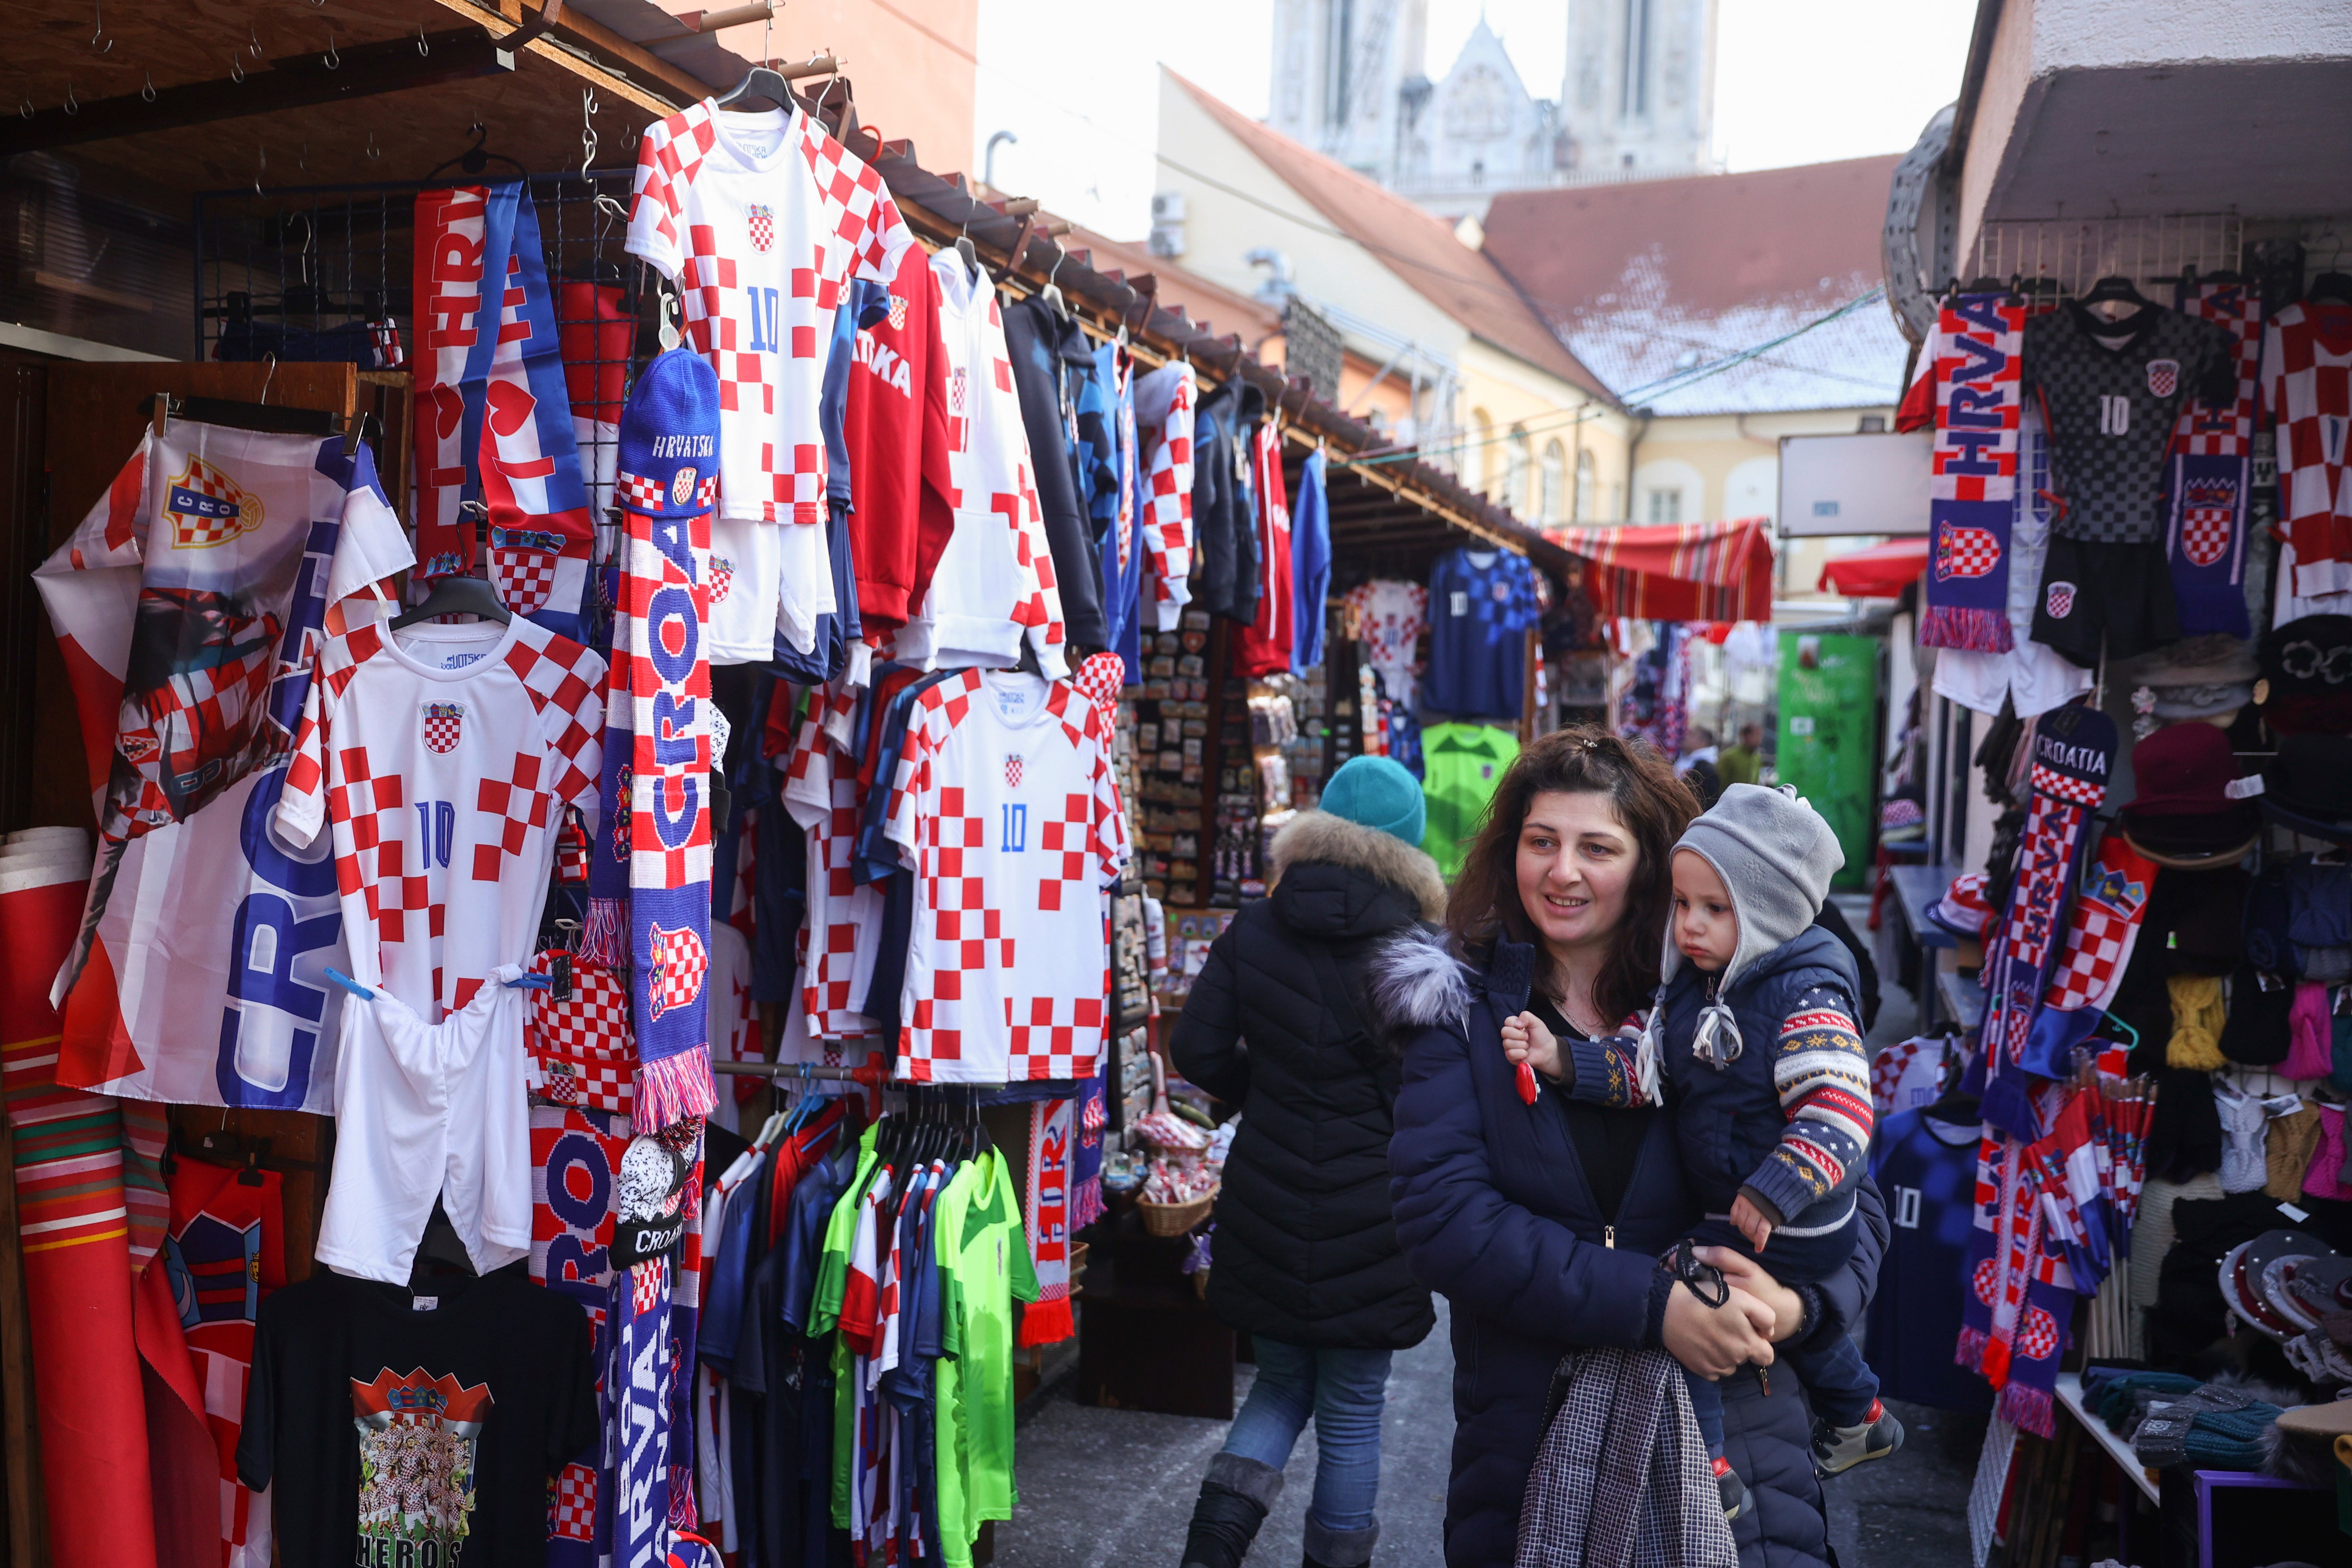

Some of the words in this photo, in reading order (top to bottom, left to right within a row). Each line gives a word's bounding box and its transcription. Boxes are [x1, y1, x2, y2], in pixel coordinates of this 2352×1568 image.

[748, 286, 778, 354] 10
[2100, 395, 2130, 435] 10
[652, 435, 714, 458] HRVATSKA
[177, 496, 230, 515] CRO
[2036, 733, 2106, 776] CROATIA
[414, 801, 455, 869] 10
[1001, 803, 1027, 852] 10
[2027, 808, 2067, 945] HRVA
[1894, 1184, 1921, 1229] 10
